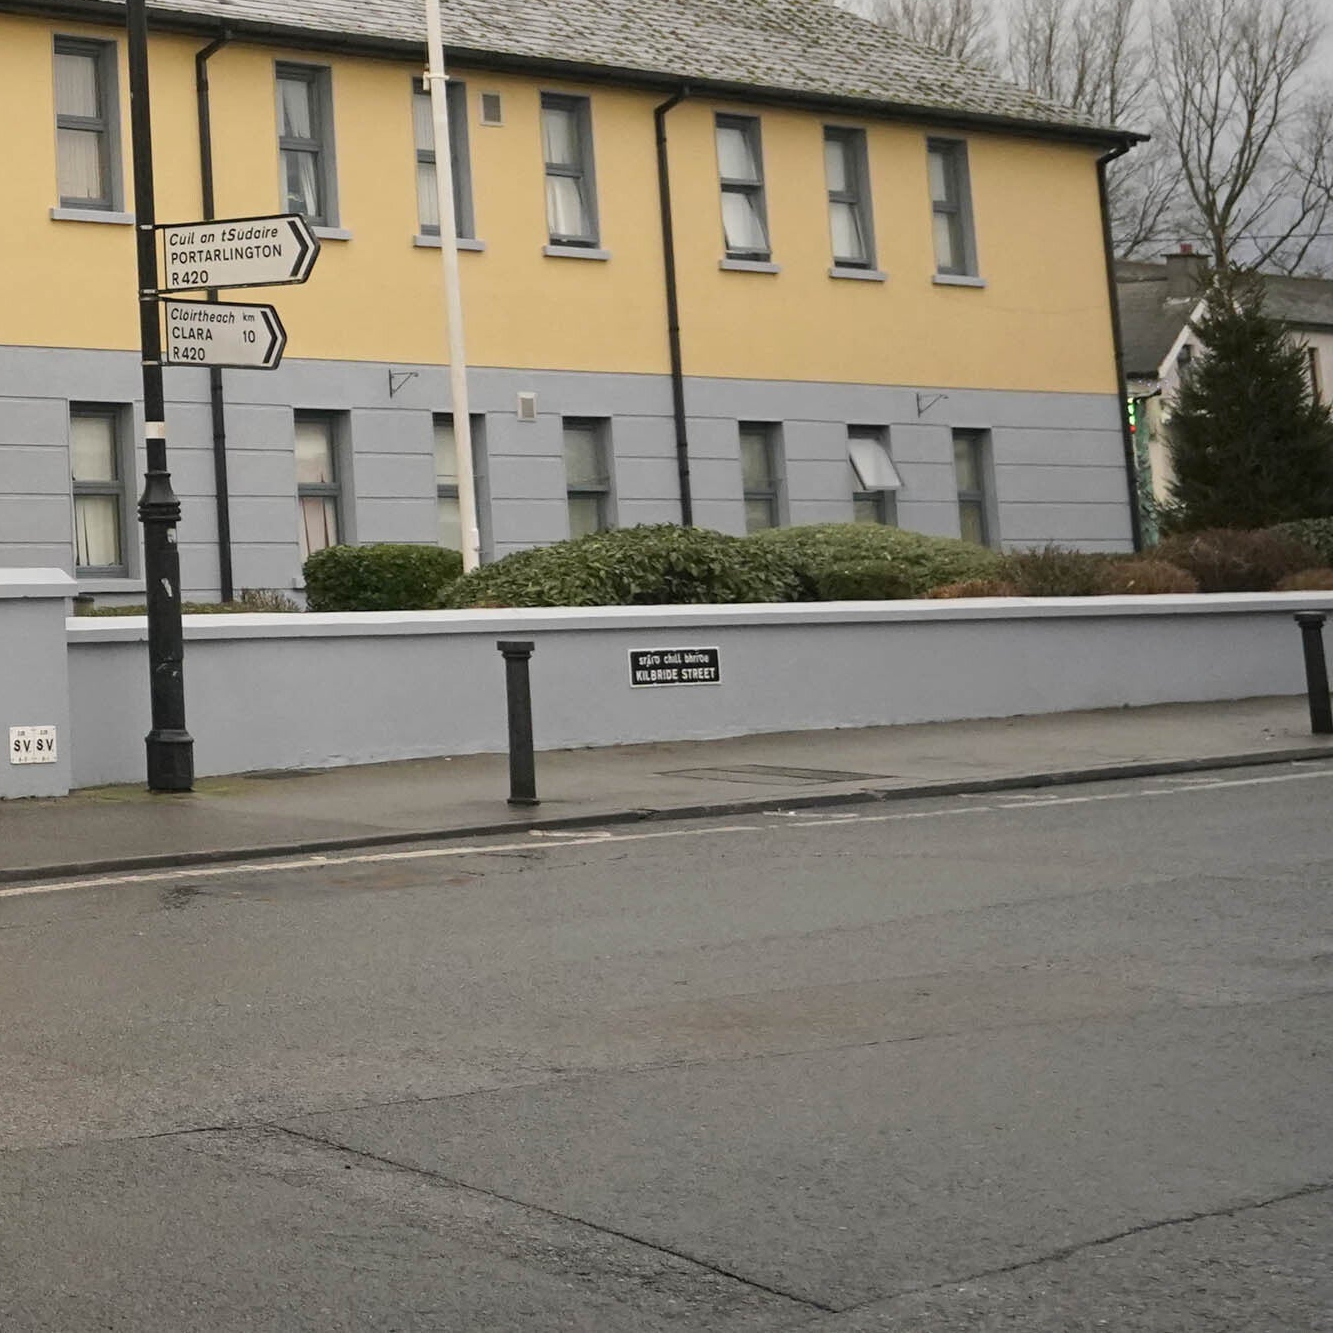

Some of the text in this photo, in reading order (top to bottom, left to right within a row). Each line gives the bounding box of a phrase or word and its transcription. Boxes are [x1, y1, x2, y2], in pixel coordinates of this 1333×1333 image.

[200, 232, 215, 244] an
[171, 244, 283, 265] PORTARLINGTON
[242, 311, 255, 322] km
[172, 325, 256, 343] CLARA 10
[635, 667, 715, 682] KILBRIDE STREET
